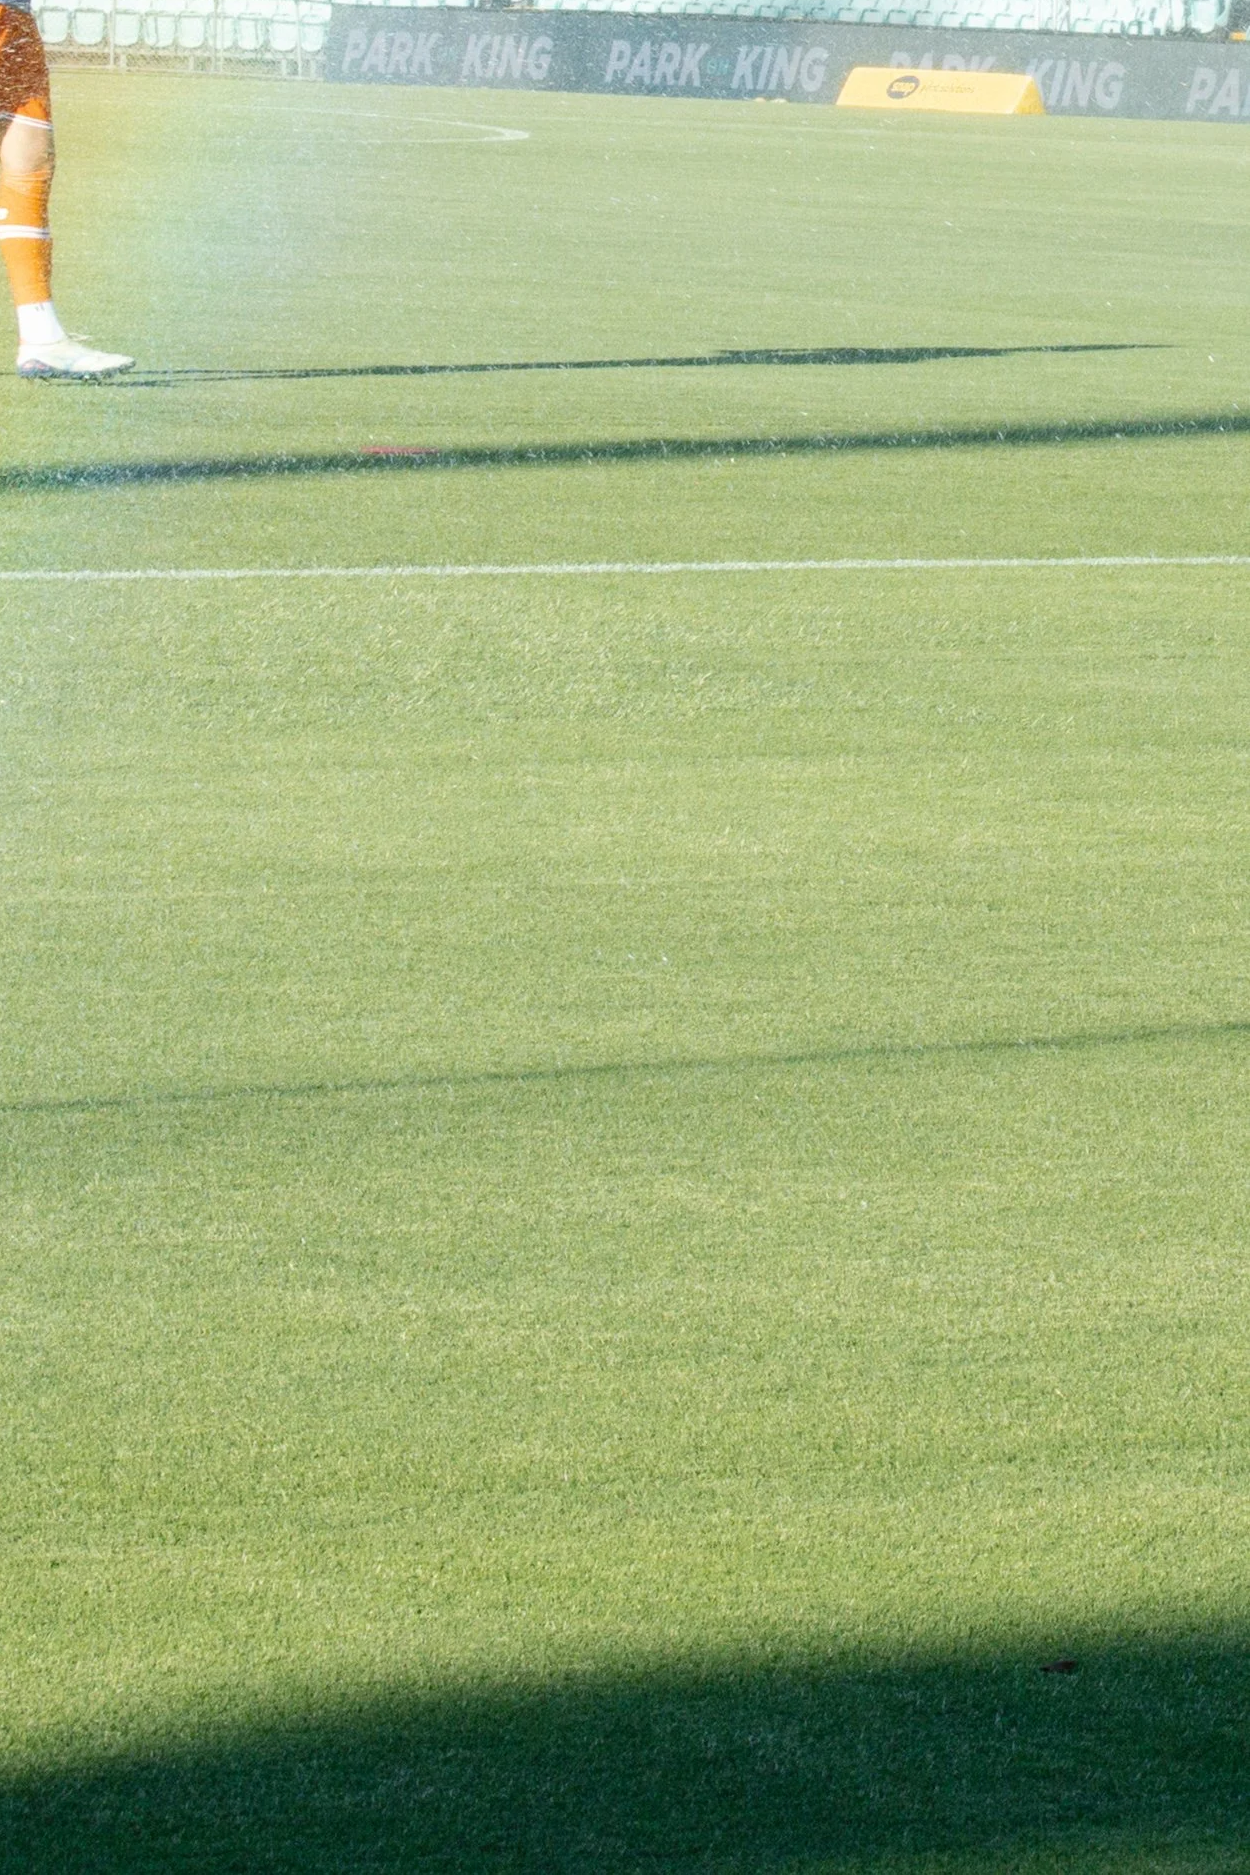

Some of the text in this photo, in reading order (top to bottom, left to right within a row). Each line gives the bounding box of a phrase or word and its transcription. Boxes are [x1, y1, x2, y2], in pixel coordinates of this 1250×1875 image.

[341, 28, 553, 80] PARK KING
[604, 39, 710, 87] PARK
[731, 44, 829, 92] KING
[1025, 57, 1126, 109] KING
[1185, 66, 1250, 116] PA
